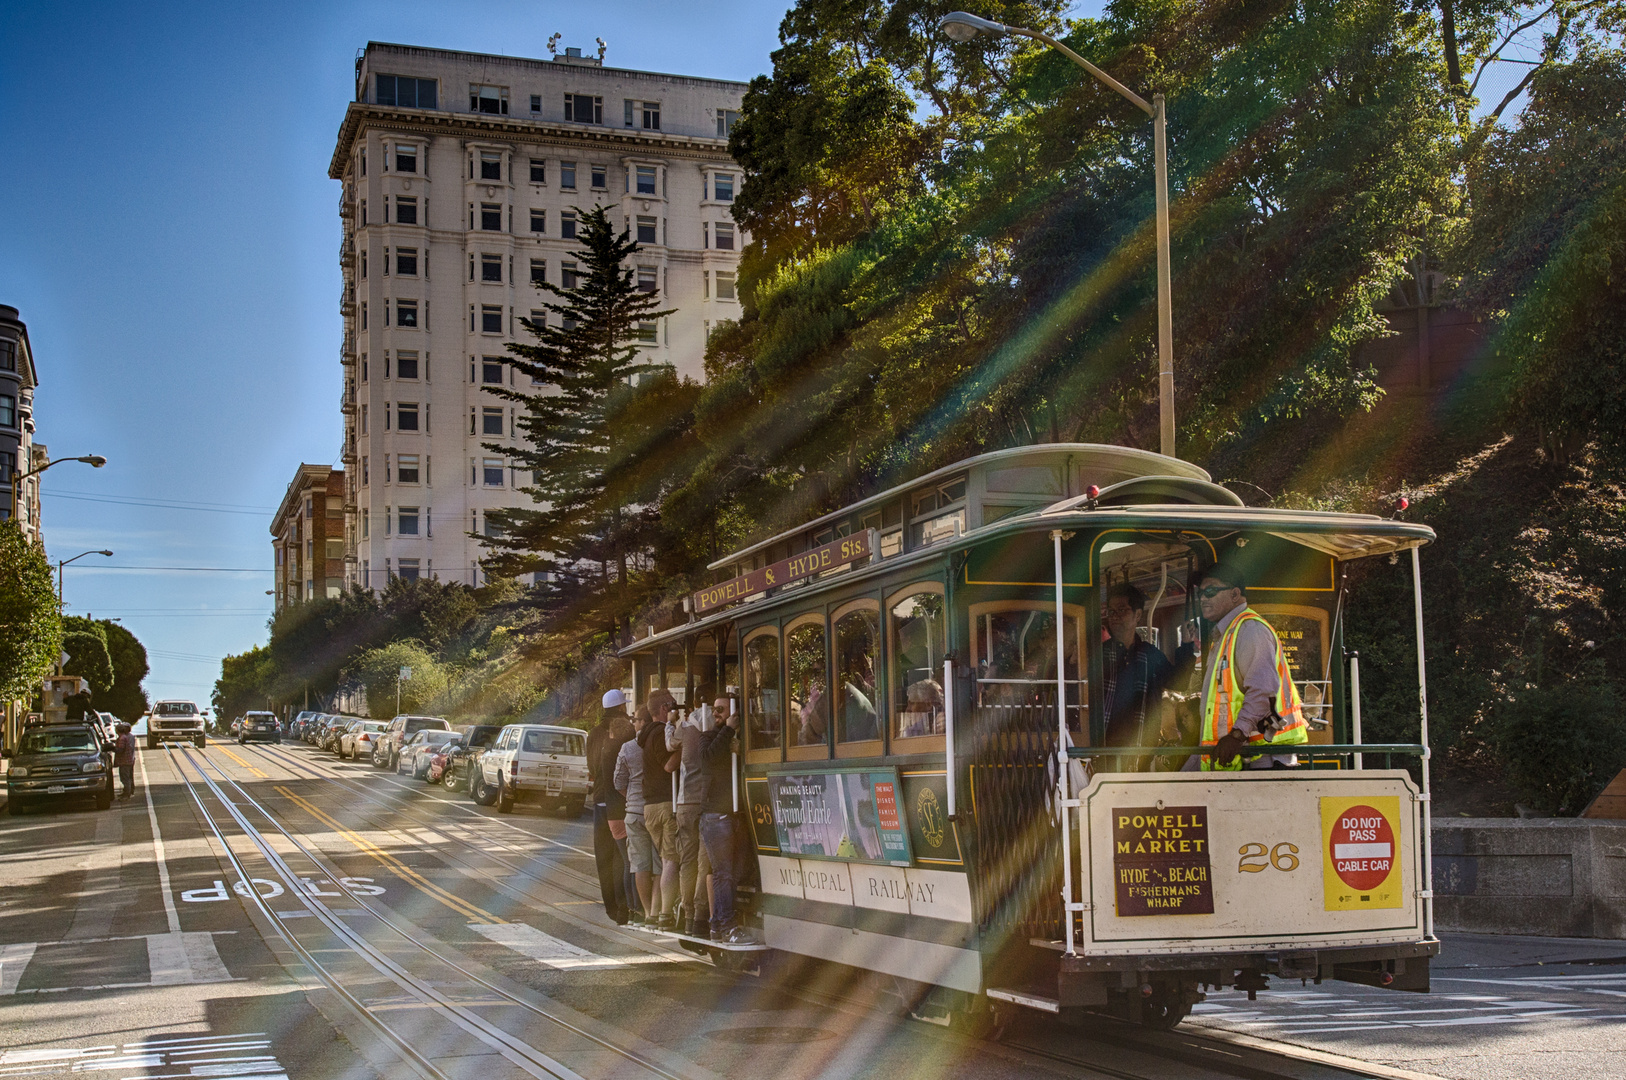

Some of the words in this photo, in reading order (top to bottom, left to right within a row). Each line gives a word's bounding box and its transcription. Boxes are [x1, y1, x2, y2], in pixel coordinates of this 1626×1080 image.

[700, 578, 754, 608] POWELL
[765, 568, 776, 585] &
[789, 548, 832, 577] HYDE
[841, 539, 865, 560] Sts.
[1277, 631, 1289, 639] ONE
[1290, 631, 1303, 639] WAY
[802, 784, 822, 795] BEAUTY
[754, 803, 772, 825] 26
[807, 800, 832, 825] Earle
[1118, 815, 1203, 830] POWELL
[1342, 817, 1358, 830] DO
[1360, 817, 1382, 829] NOT
[1141, 828, 1183, 839] AND
[1349, 829, 1376, 841] PASS
[1117, 840, 1205, 854] MARKET
[1238, 841, 1300, 874] 26
[1337, 860, 1368, 872] CABLE
[1370, 860, 1390, 872] CAR
[1120, 868, 1150, 884] HYDE
[1152, 869, 1167, 883] AND
[1169, 866, 1207, 883] BEACH
[181, 876, 387, 903] STOP
[779, 868, 846, 893] MUNICIPAL
[868, 877, 936, 904] RAILWAY
[1128, 886, 1201, 897] FISHERMANS
[1146, 897, 1183, 908] WHARF
